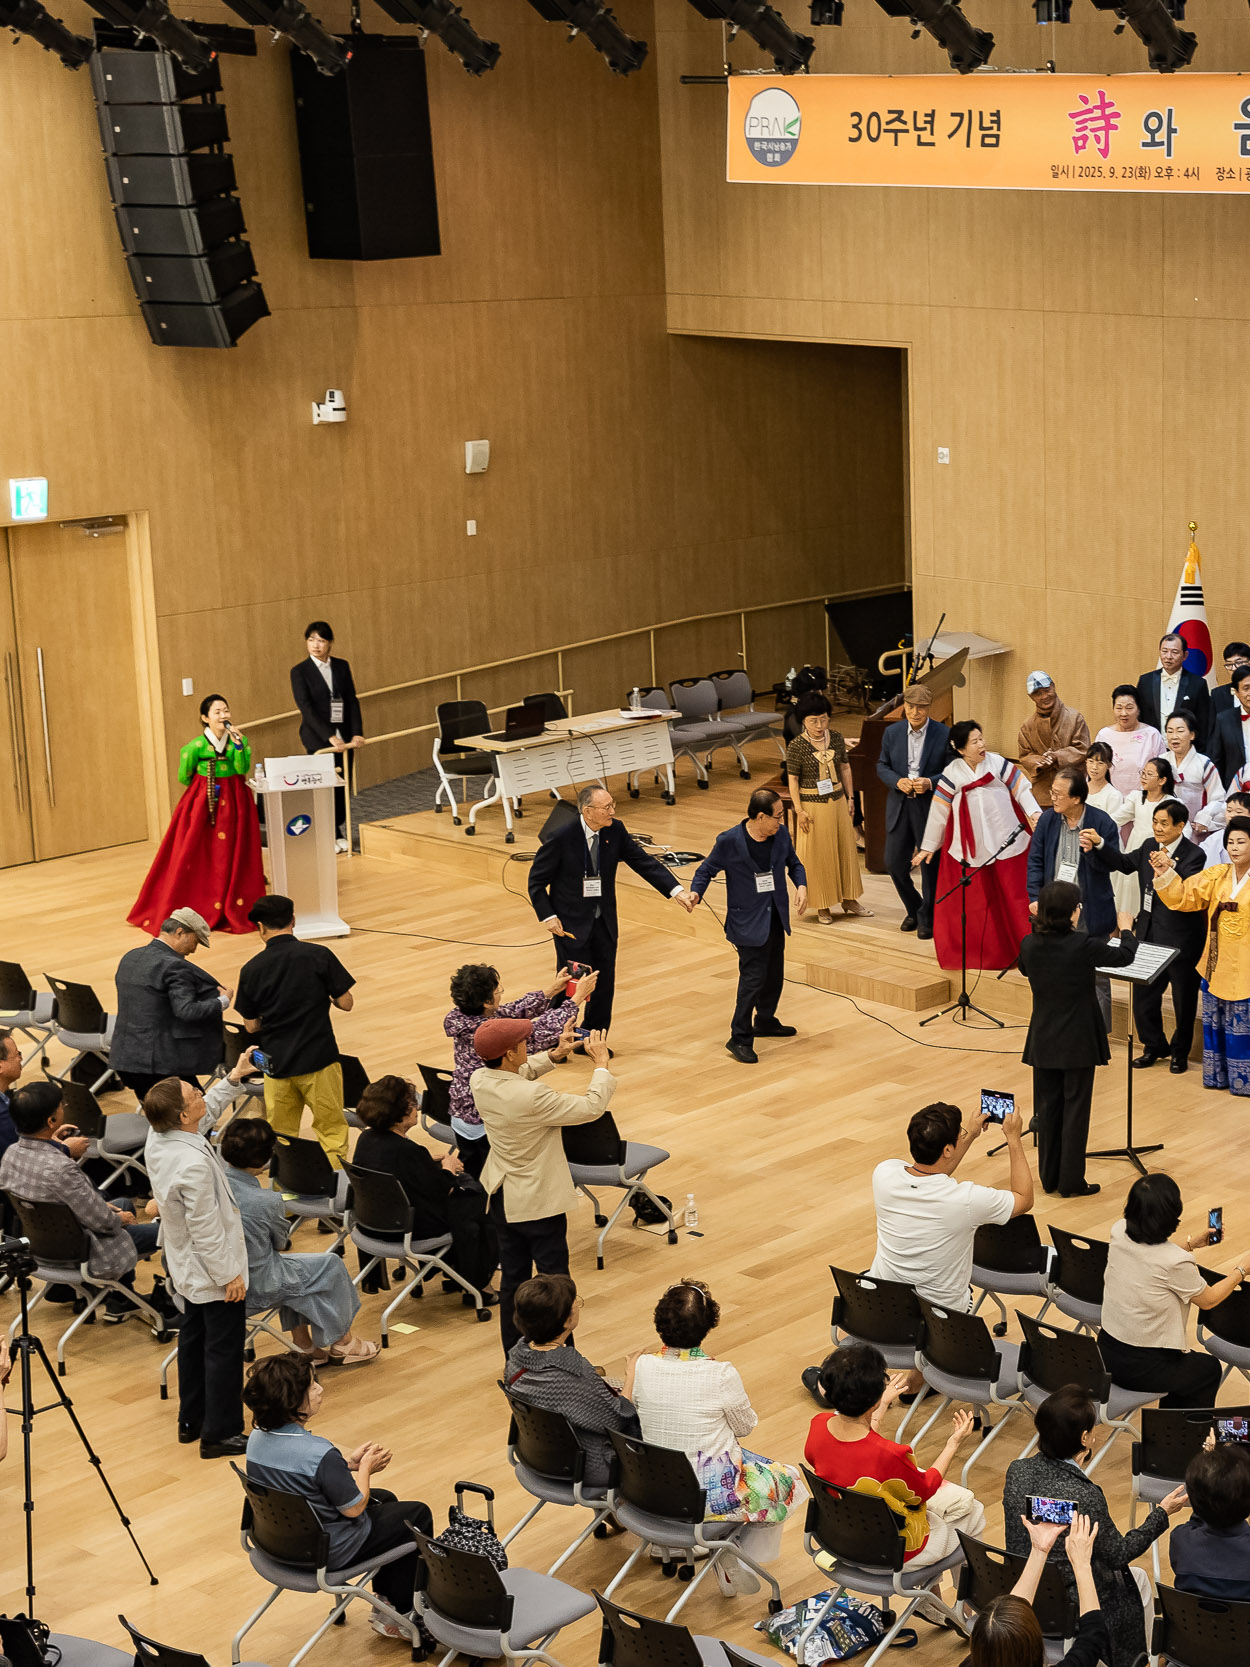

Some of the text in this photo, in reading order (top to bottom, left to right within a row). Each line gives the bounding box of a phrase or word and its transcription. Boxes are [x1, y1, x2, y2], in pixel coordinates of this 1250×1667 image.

[848, 109, 1001, 148] 30주년 기념
[1050, 164, 1070, 179] 일시
[1078, 166, 1106, 179] 2025.
[1108, 166, 1118, 179] 9.
[1121, 166, 1151, 180] 23(화)
[1154, 166, 1174, 180] 오후
[1183, 166, 1200, 180] 4시
[1215, 167, 1236, 182] 장소
